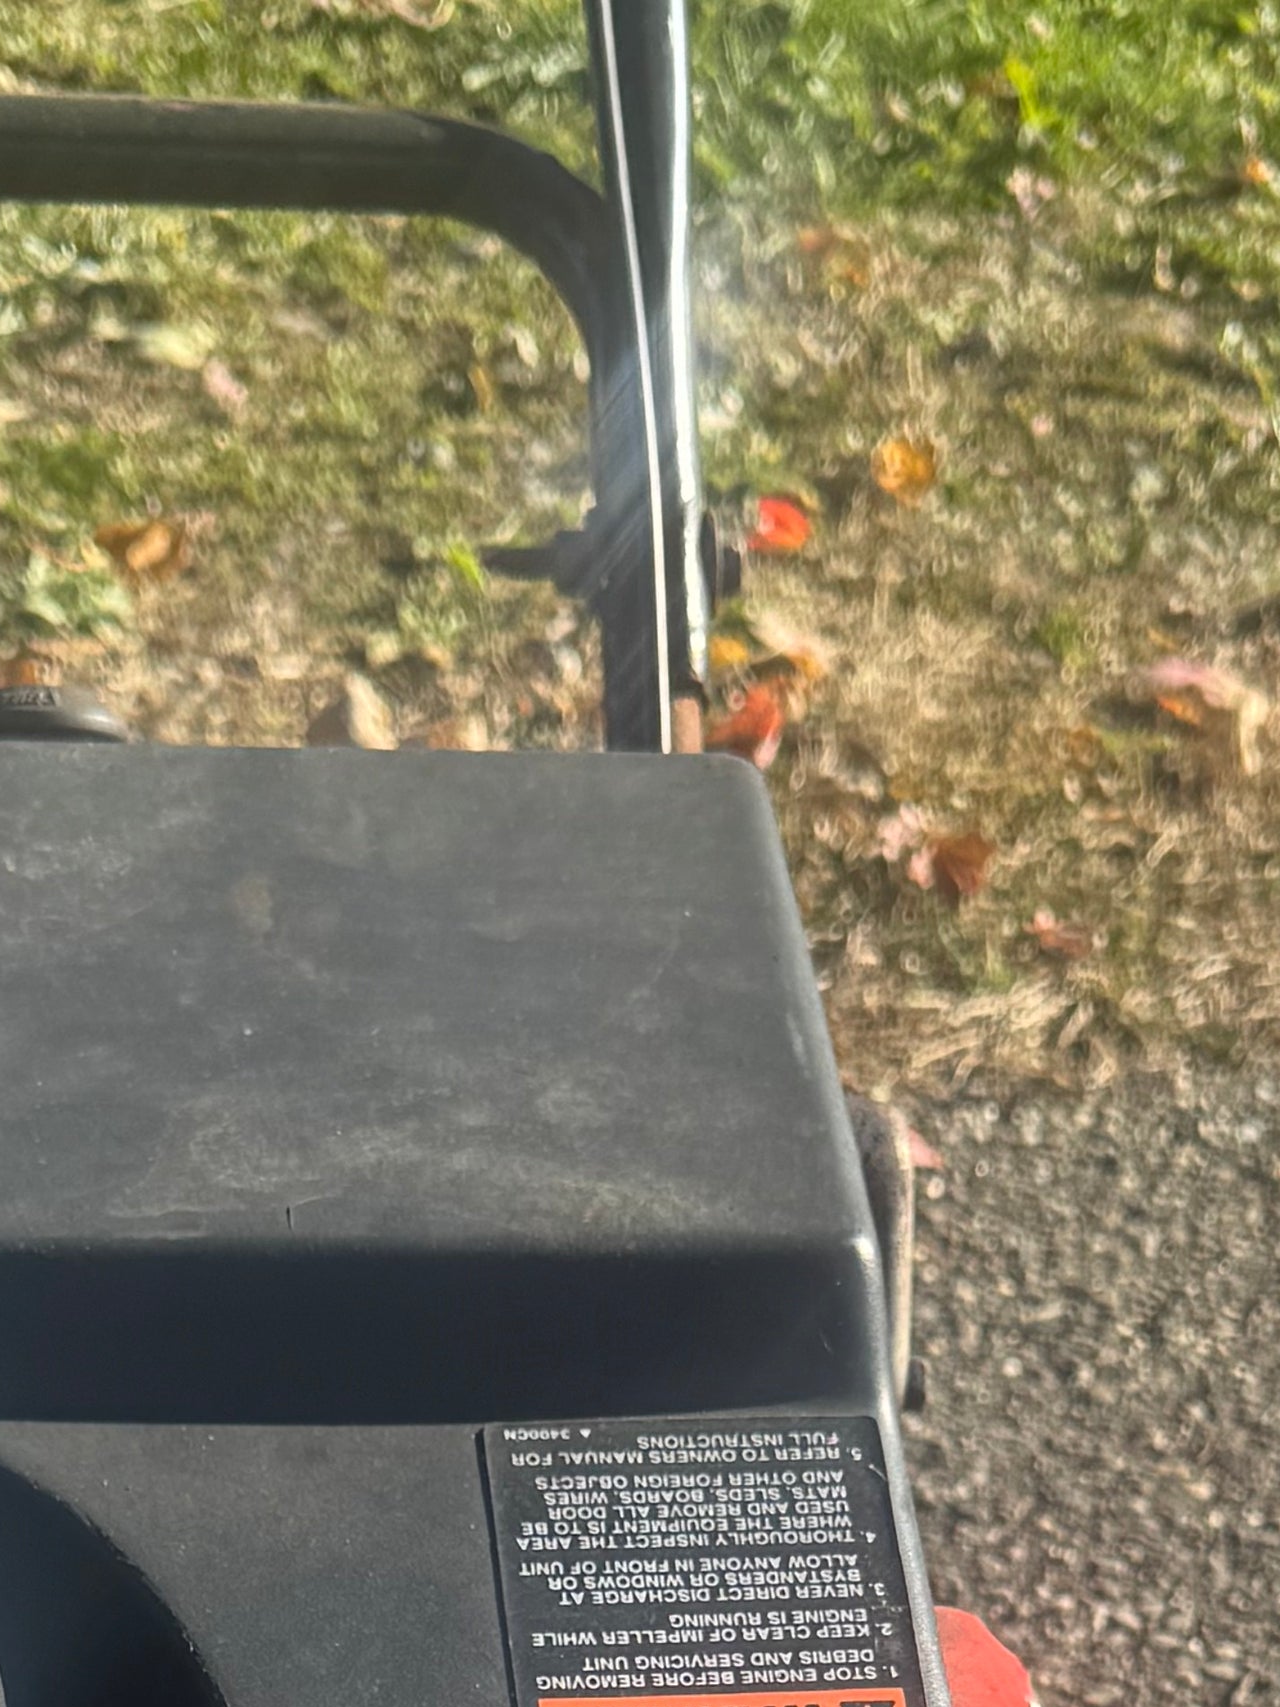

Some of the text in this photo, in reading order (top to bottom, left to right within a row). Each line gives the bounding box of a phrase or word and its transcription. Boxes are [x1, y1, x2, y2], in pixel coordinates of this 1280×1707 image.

[637, 1432, 838, 1449] FULL INSTRUCTIONS
[511, 1453, 552, 1466] FOR
[558, 1452, 643, 1465] MANUAL
[649, 1450, 736, 1464] OWNERS
[742, 1449, 770, 1462] TO
[775, 1447, 840, 1461] REFER
[534, 1470, 843, 1490] AND OTHER FOREIGN OBJECTS
[543, 1492, 608, 1506] WIRES
[548, 1501, 849, 1520] USED AND REMOVE ALL DOOR
[521, 1516, 852, 1536] WHERE THE EQUIPMENT IS TO BE
[516, 1537, 571, 1551] AREA
[578, 1536, 618, 1549] THE
[624, 1533, 708, 1549] INSPECT
[716, 1530, 855, 1546] THOROUGHLY
[519, 1554, 857, 1576] ALLOW ANYONE IN FRONT OF UNIT
[548, 1569, 861, 1591] BYSTANDERS OR WINDOWS OR
[559, 1582, 885, 1606] 3. NEVER DIRECT DISCHARGE AT
[669, 1608, 868, 1628] ENGINE IS RUNNING
[532, 1623, 892, 1647] 2. KEEP CLEAR OF IMPELLER WHILE
[582, 1649, 874, 1671] DEBRIS AND SERVICING UNIT
[536, 1666, 899, 1690] 1. STOP ENGINE BEFORE REMOVING
